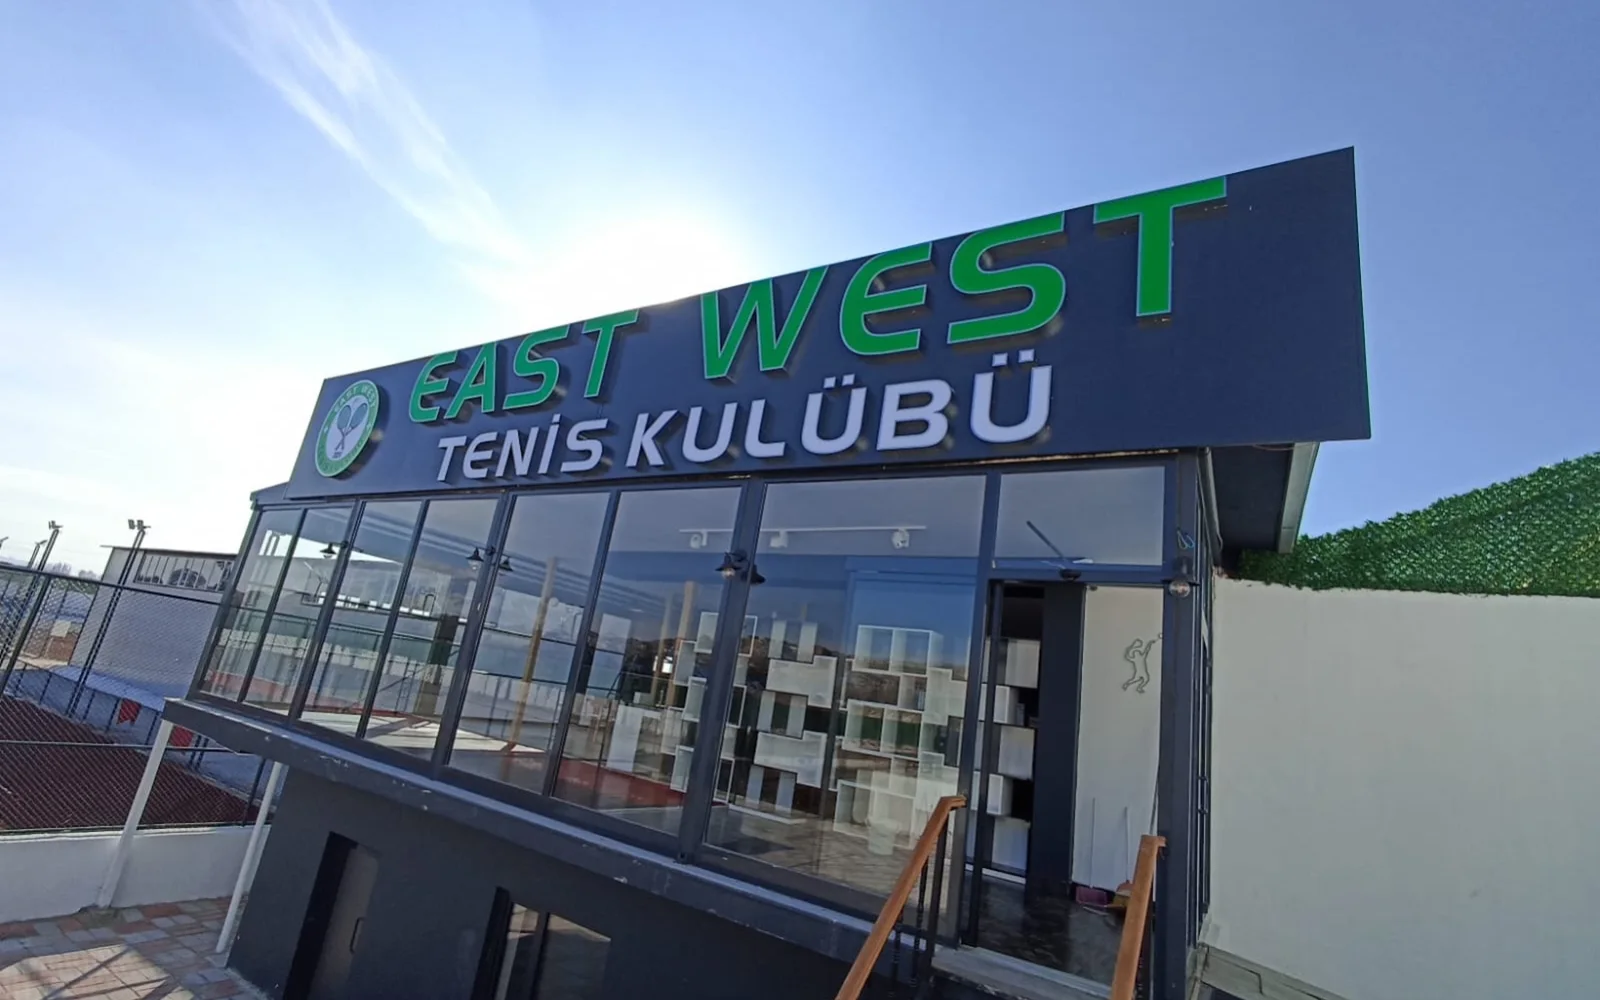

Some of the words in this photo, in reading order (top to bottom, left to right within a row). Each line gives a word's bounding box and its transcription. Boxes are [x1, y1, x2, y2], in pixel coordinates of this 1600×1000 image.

[409, 309, 640, 423] EAST
[701, 175, 1227, 380] WEST
[437, 413, 609, 482] TENİS
[625, 349, 1053, 468] KULÜBÜ
